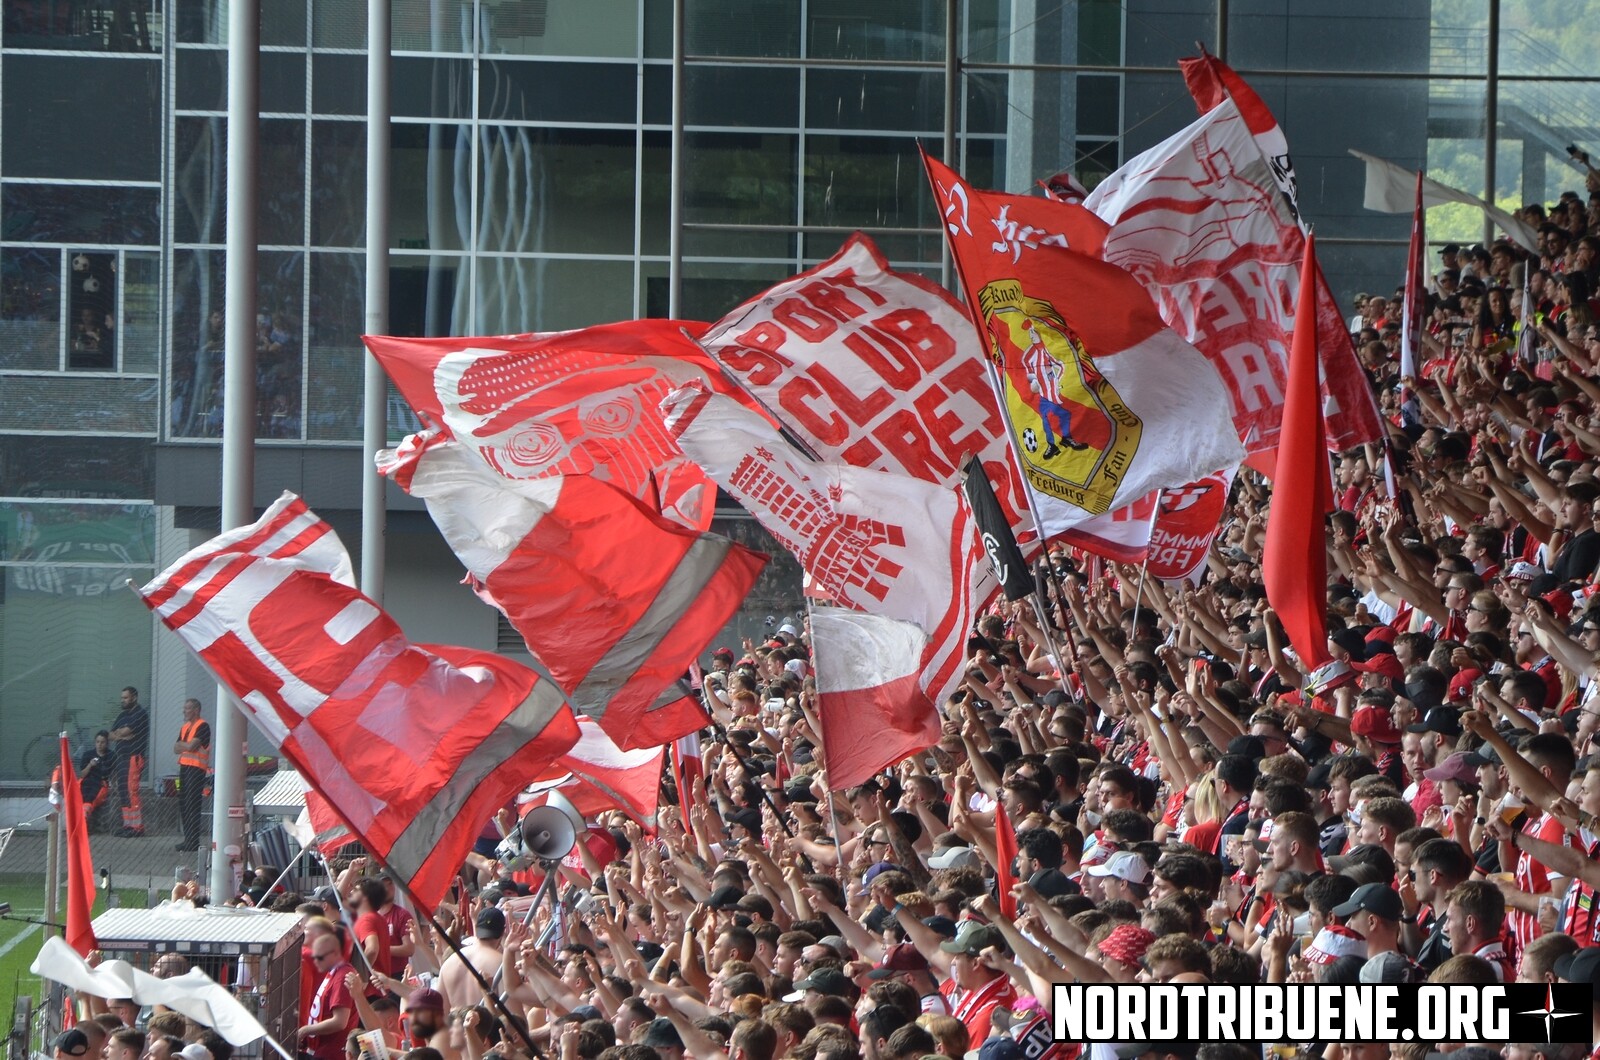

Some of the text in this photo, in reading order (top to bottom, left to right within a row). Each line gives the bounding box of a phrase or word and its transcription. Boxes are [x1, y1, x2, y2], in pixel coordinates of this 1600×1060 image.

[719, 267, 887, 385] SPORT
[778, 308, 957, 446] CLUB
[1110, 403, 1139, 428] Club
[1027, 468, 1085, 505] Freiburg
[1103, 450, 1127, 487] Fan
